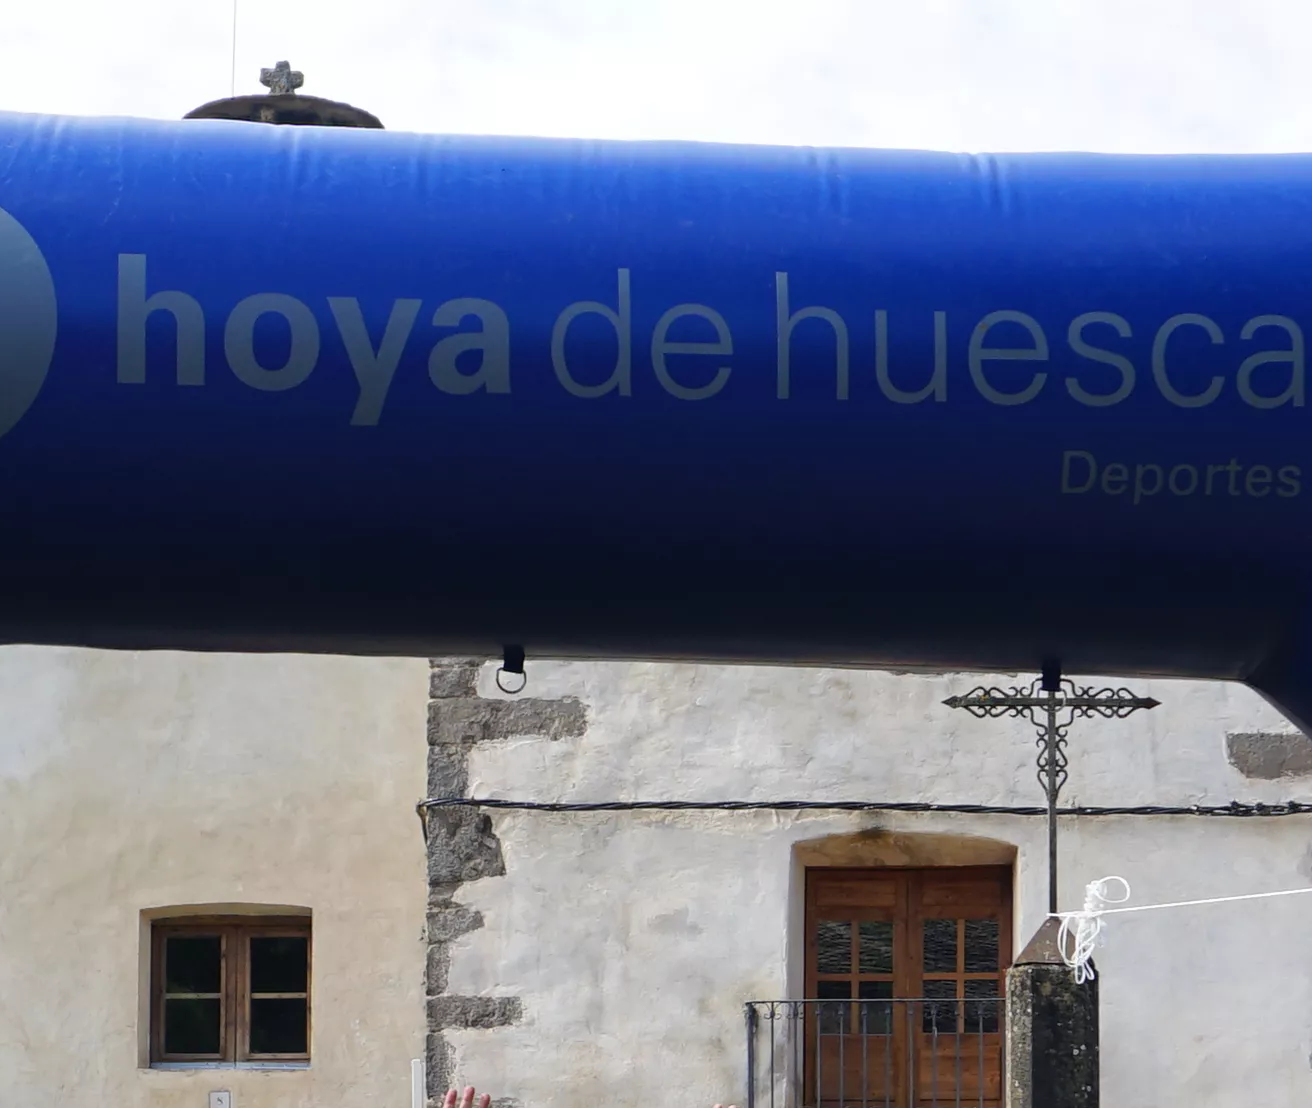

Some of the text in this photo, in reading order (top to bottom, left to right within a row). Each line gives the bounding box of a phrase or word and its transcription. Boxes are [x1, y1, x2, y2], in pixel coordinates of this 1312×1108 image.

[117, 253, 1306, 426] hoya de huesca
[1061, 449, 1303, 506] Deportes
